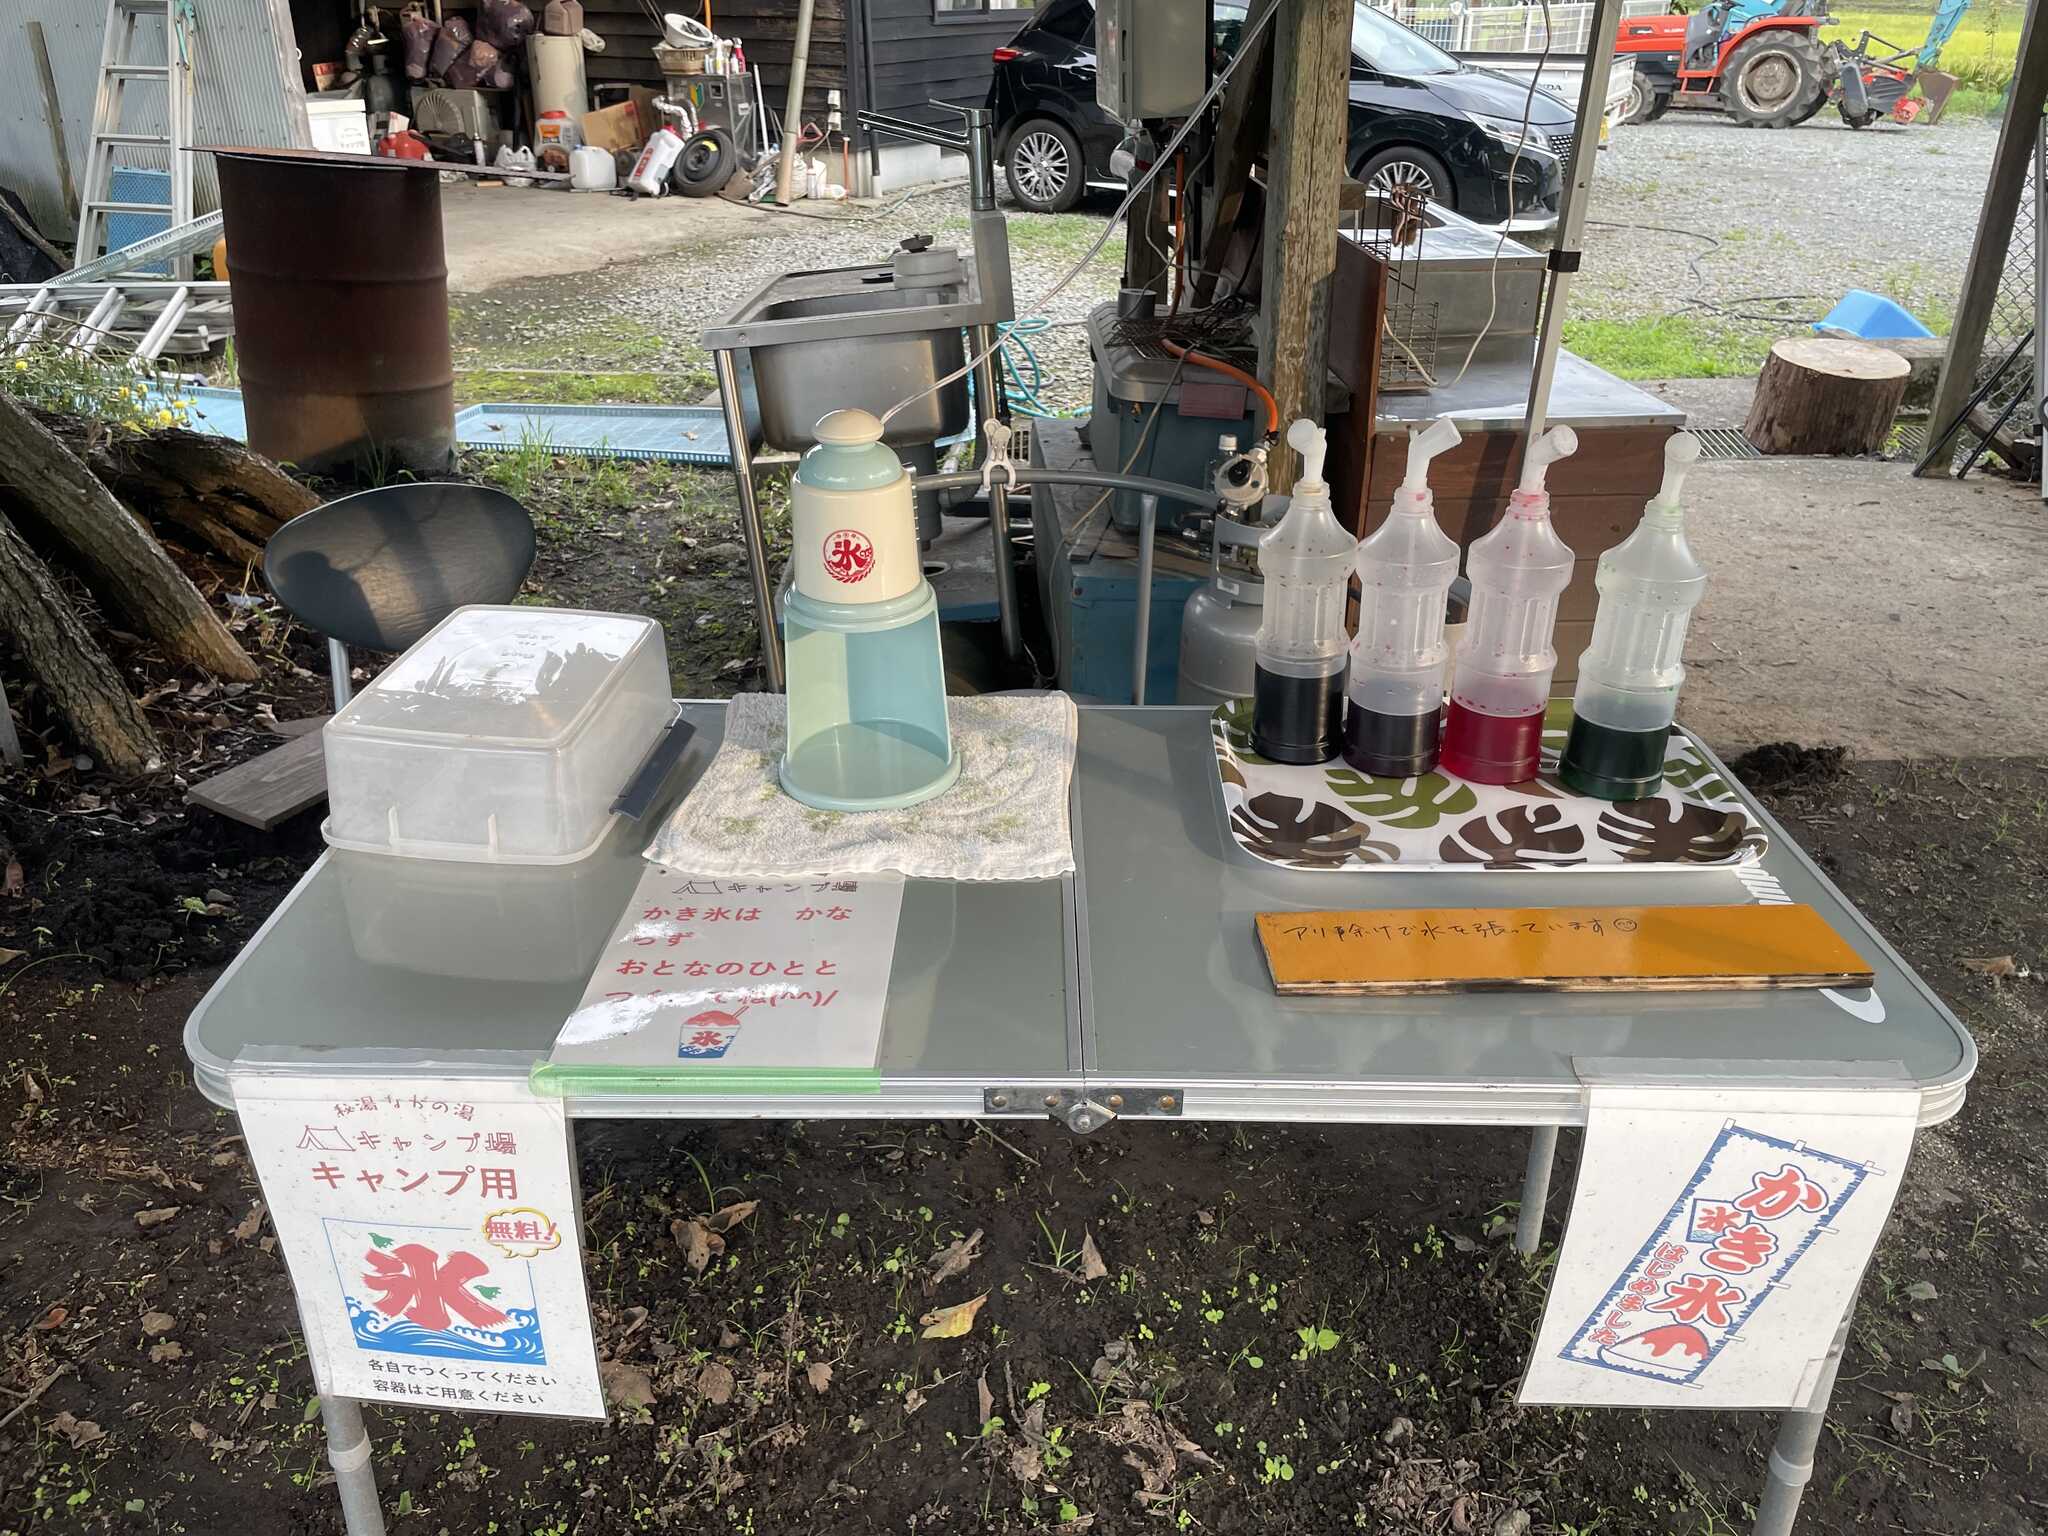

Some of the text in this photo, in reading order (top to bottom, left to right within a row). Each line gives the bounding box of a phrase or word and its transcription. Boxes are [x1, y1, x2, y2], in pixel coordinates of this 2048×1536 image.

[831, 539, 868, 571] 氷
[642, 905, 853, 922] かき氷は かな
[616, 960, 839, 976] おとなのひとと
[689, 1030, 724, 1047] 氷
[356, 1131, 517, 1155] キャンプ場
[311, 1160, 518, 1200] キャンプ用
[486, 1220, 557, 1241] 無料!
[1645, 1163, 1829, 1328] かき氷
[360, 1243, 514, 1331] 氷
[1588, 1241, 1689, 1346] はじめました
[368, 1358, 558, 1387] 各自でつくってください
[373, 1378, 545, 1405] 容器はご用意ください
